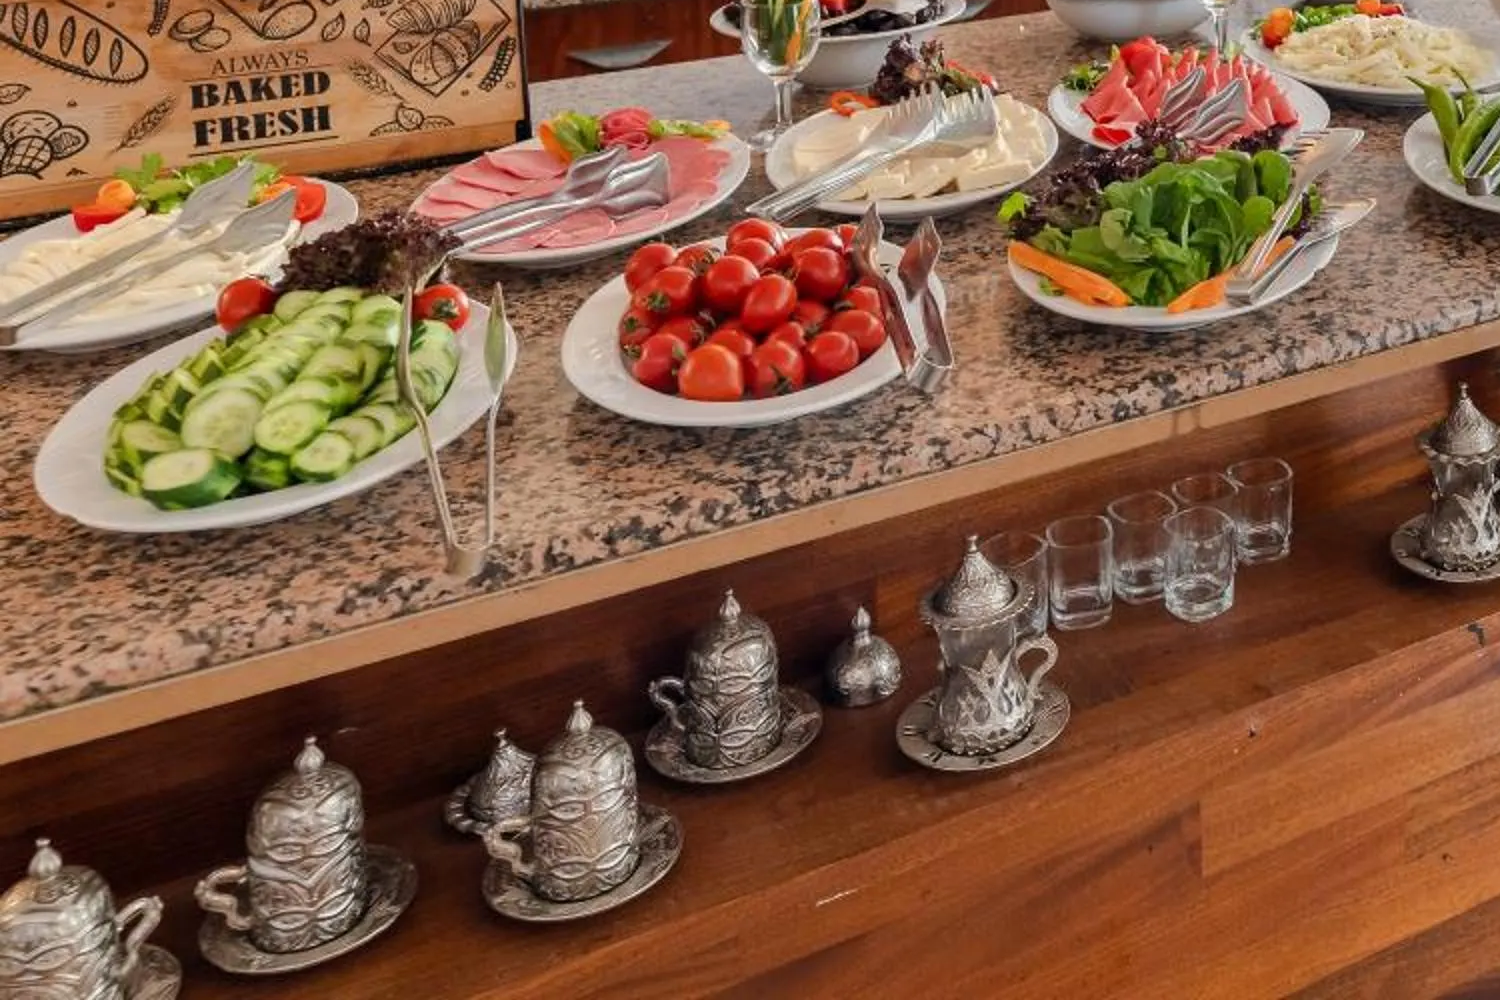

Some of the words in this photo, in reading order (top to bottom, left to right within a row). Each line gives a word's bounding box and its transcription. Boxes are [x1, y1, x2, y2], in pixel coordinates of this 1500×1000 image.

[211, 50, 310, 75] ALWAYS
[190, 71, 331, 109] BAKED
[192, 104, 332, 147] FRESH
